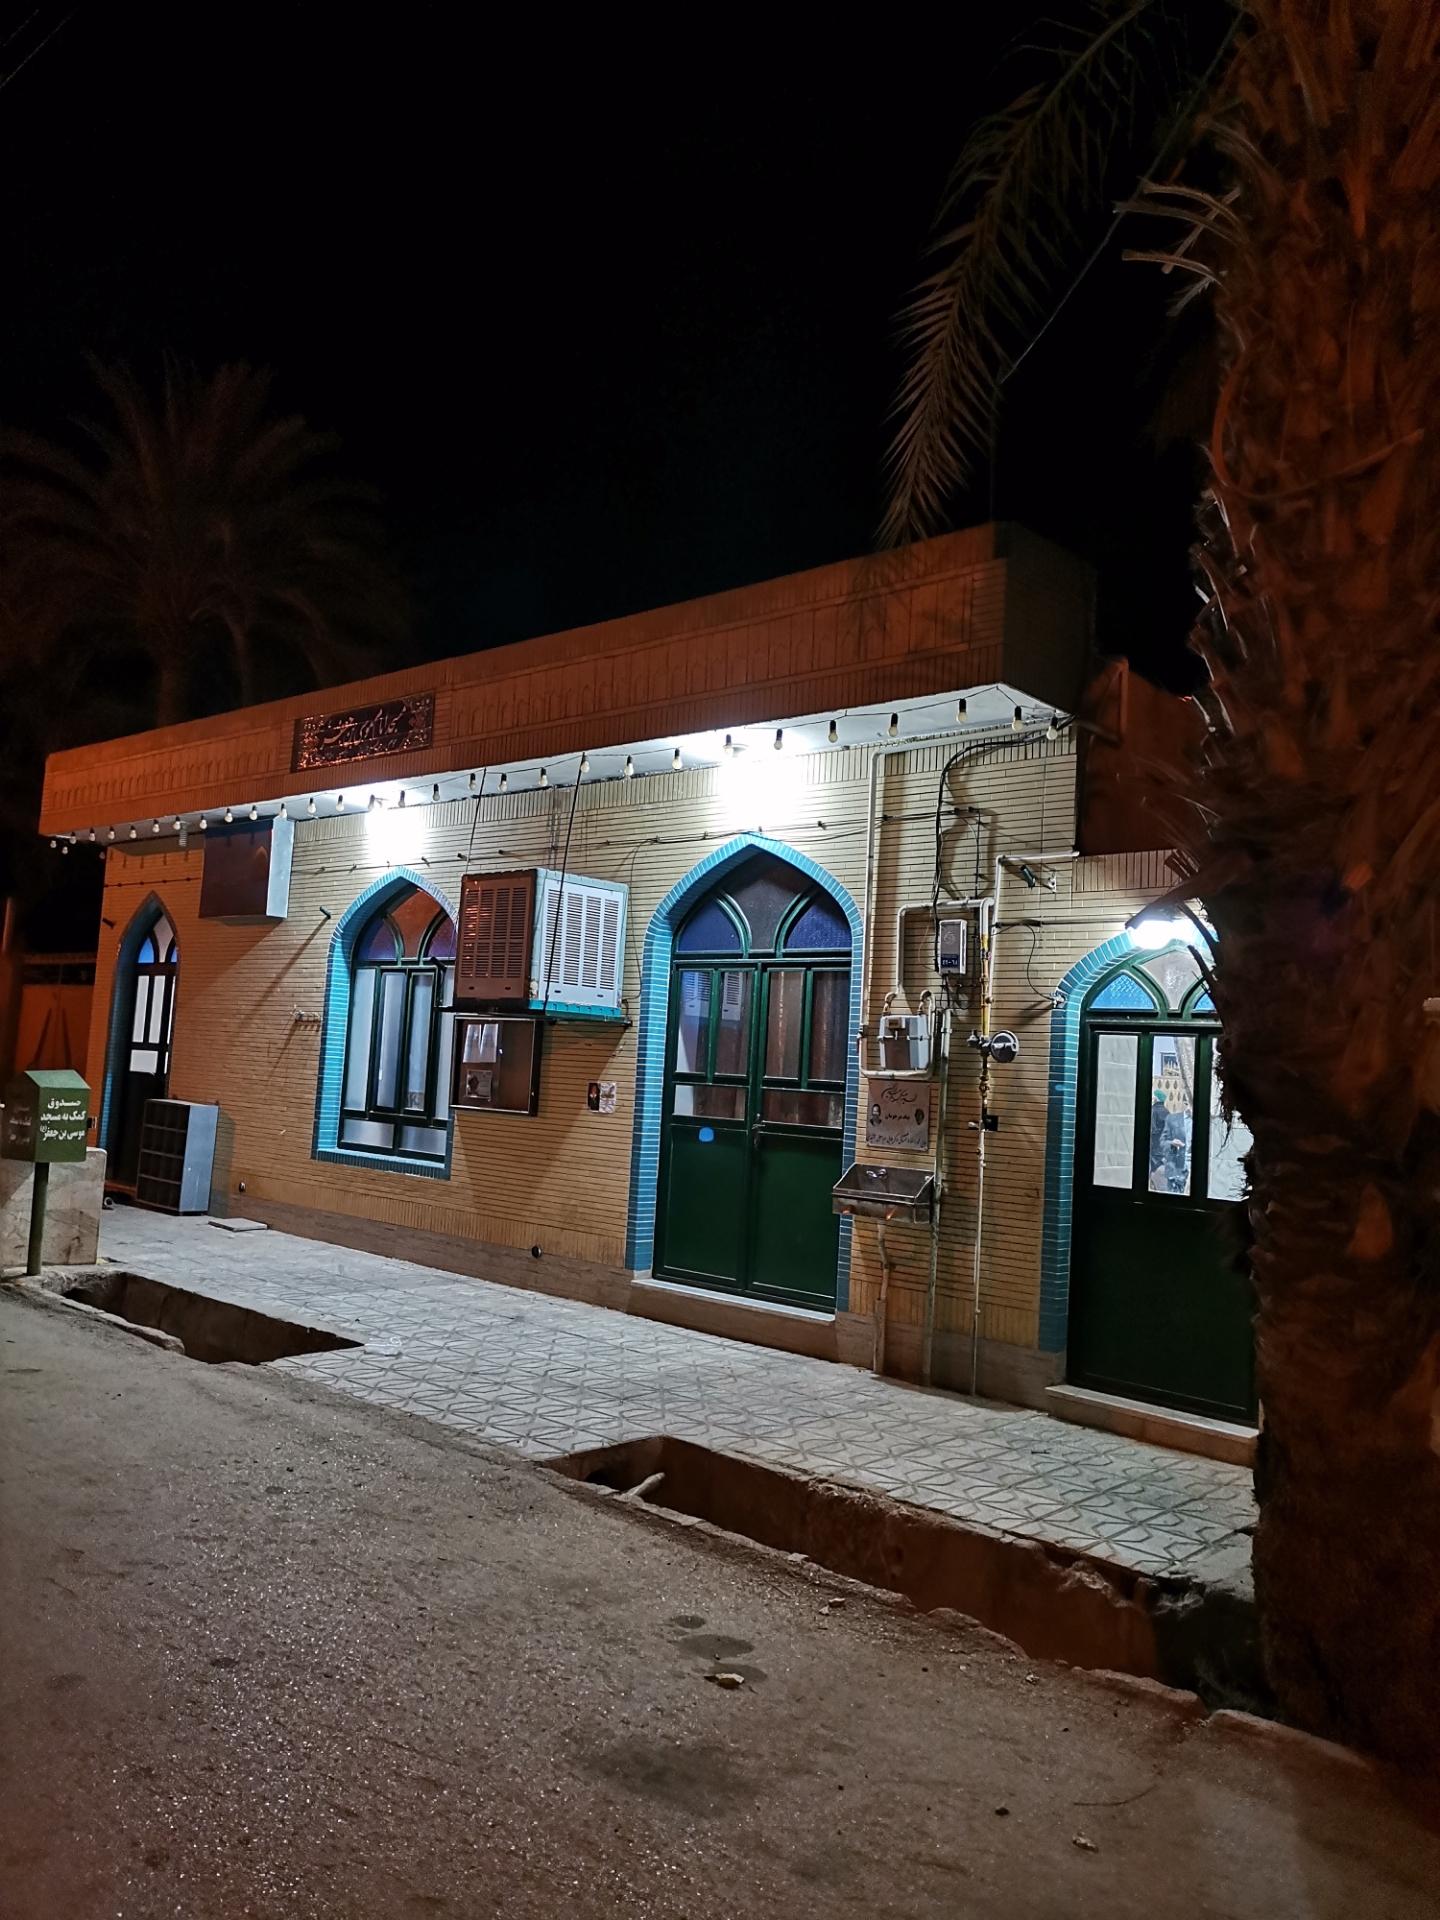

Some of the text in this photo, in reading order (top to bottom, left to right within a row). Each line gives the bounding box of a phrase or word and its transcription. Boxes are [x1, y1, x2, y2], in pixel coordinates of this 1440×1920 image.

[47, 1098, 81, 1109] صندوق
[40, 1110, 86, 1123] کمک به مسجد
[42, 1127, 60, 1141] جعفر
[67, 1130, 85, 1141] موسی
